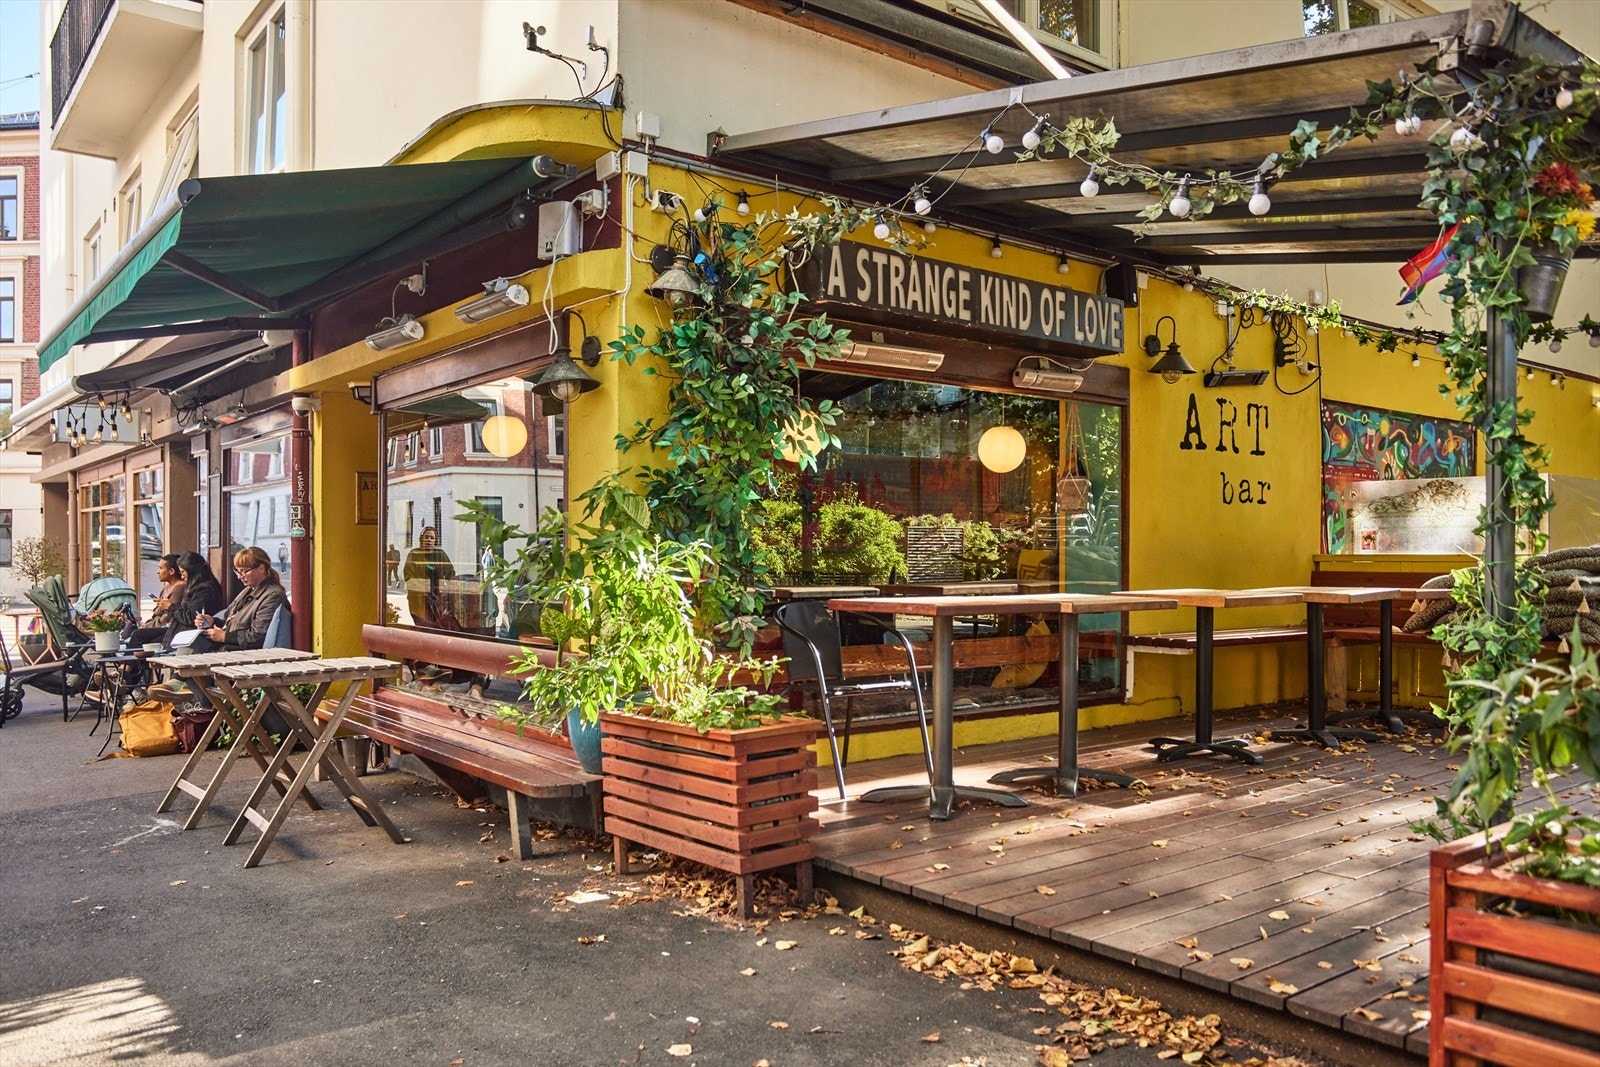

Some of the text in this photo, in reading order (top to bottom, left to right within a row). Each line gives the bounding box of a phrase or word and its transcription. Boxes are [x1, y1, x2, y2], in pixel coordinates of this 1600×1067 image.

[827, 245, 1122, 349] A STRANGE KIND OF LOVE
[1180, 393, 1269, 456] ART
[1220, 472, 1271, 505] bar
